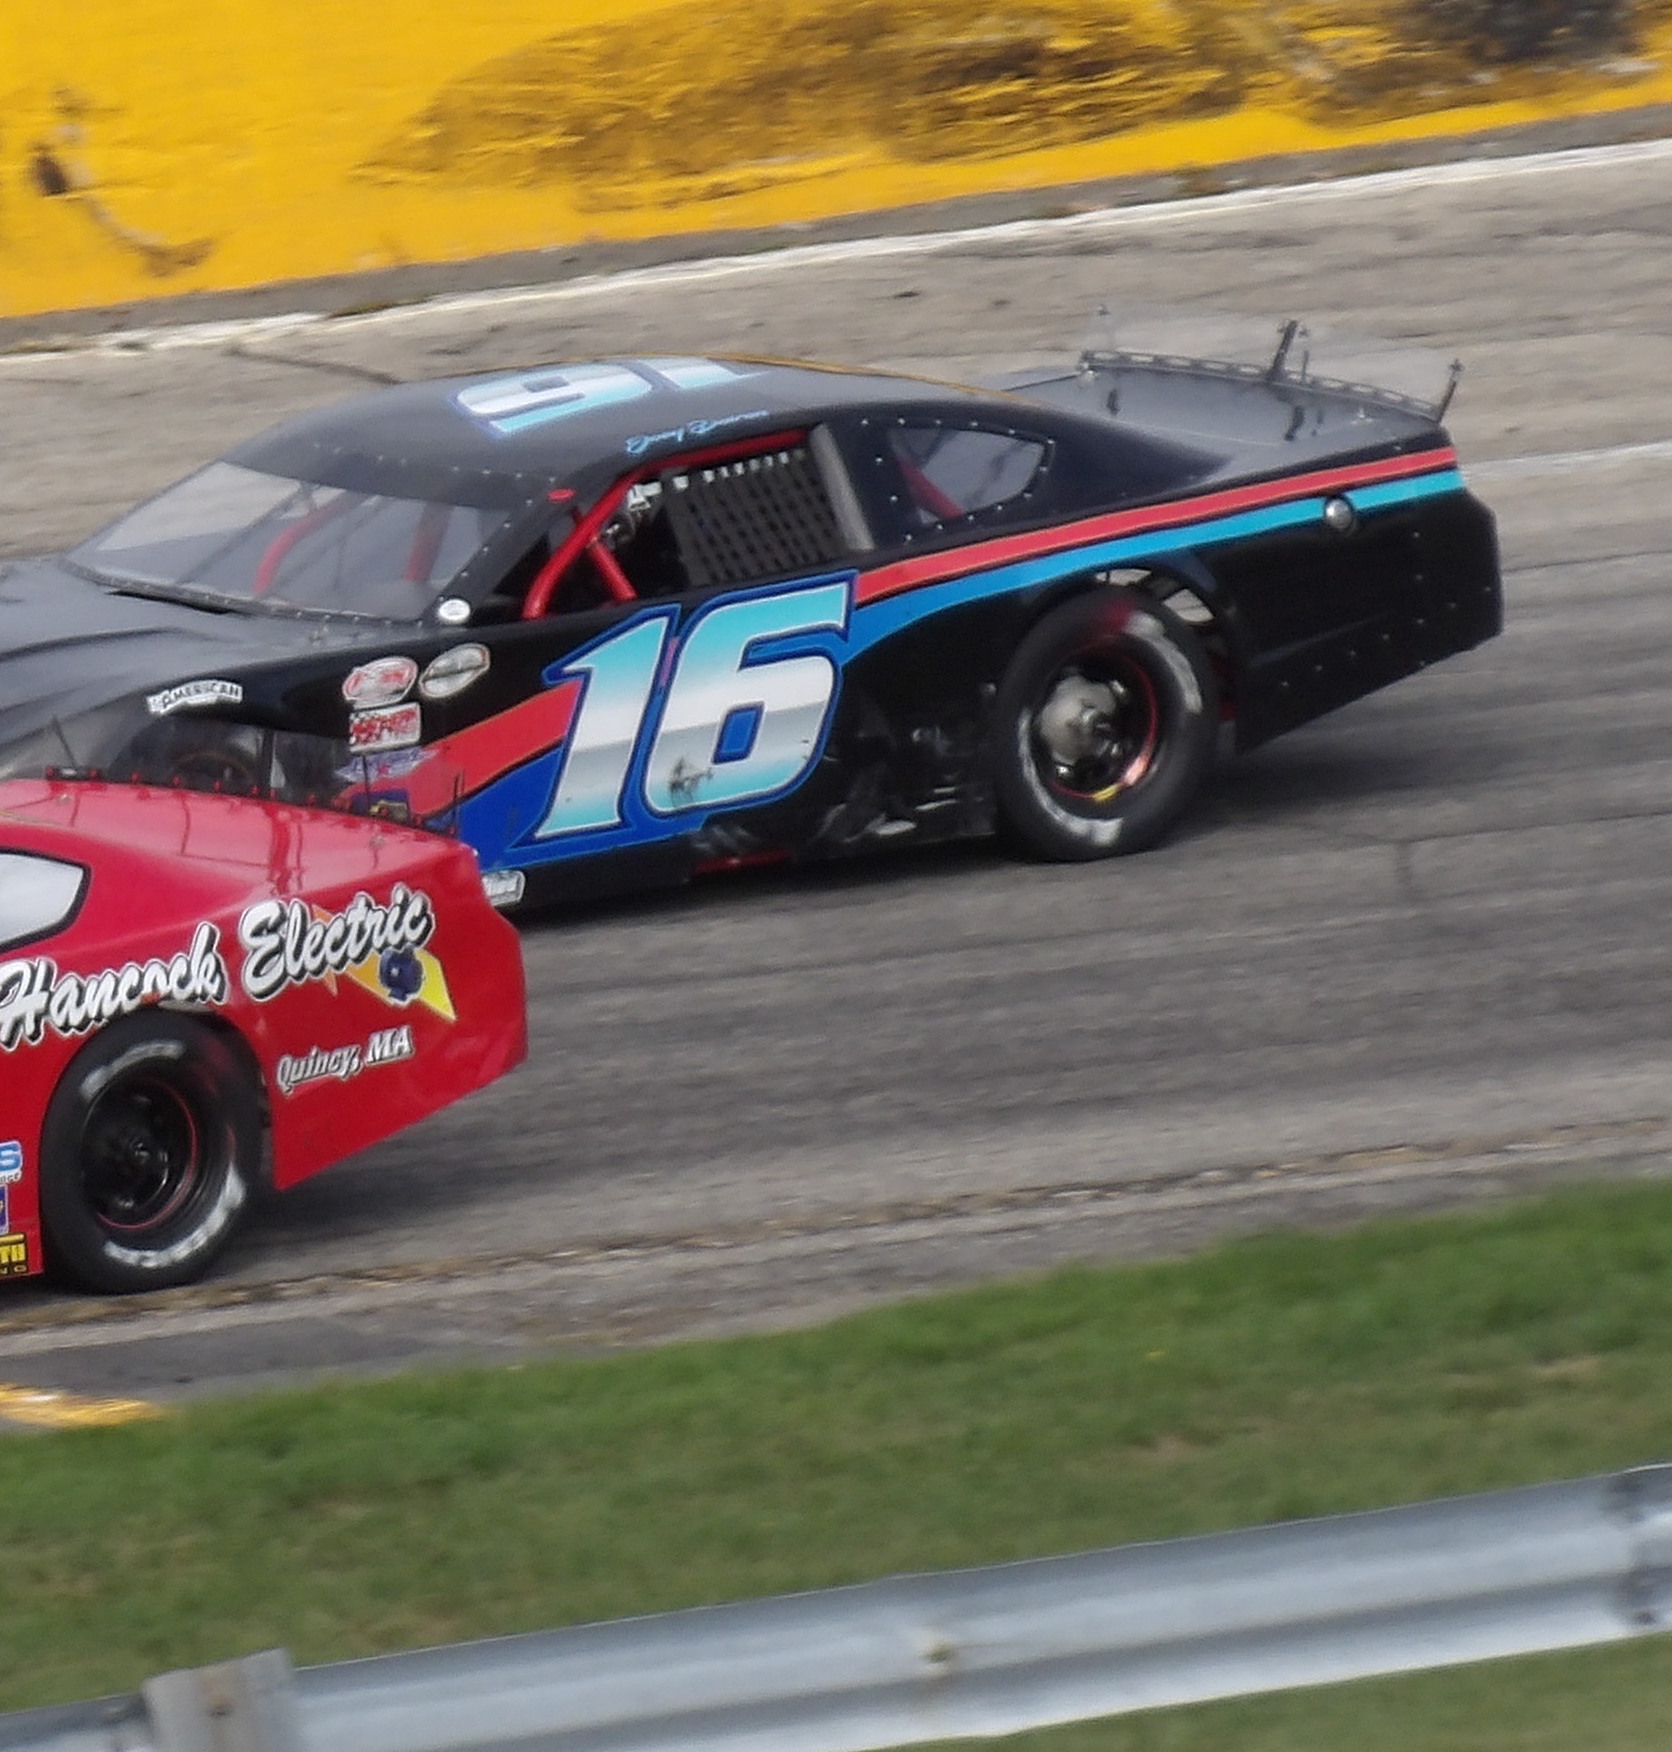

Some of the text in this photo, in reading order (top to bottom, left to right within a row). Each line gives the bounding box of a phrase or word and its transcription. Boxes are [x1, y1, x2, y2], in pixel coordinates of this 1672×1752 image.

[524, 572, 854, 845] 16
[239, 882, 435, 1002] Electric
[277, 1025, 414, 1095] Quincy, MA
